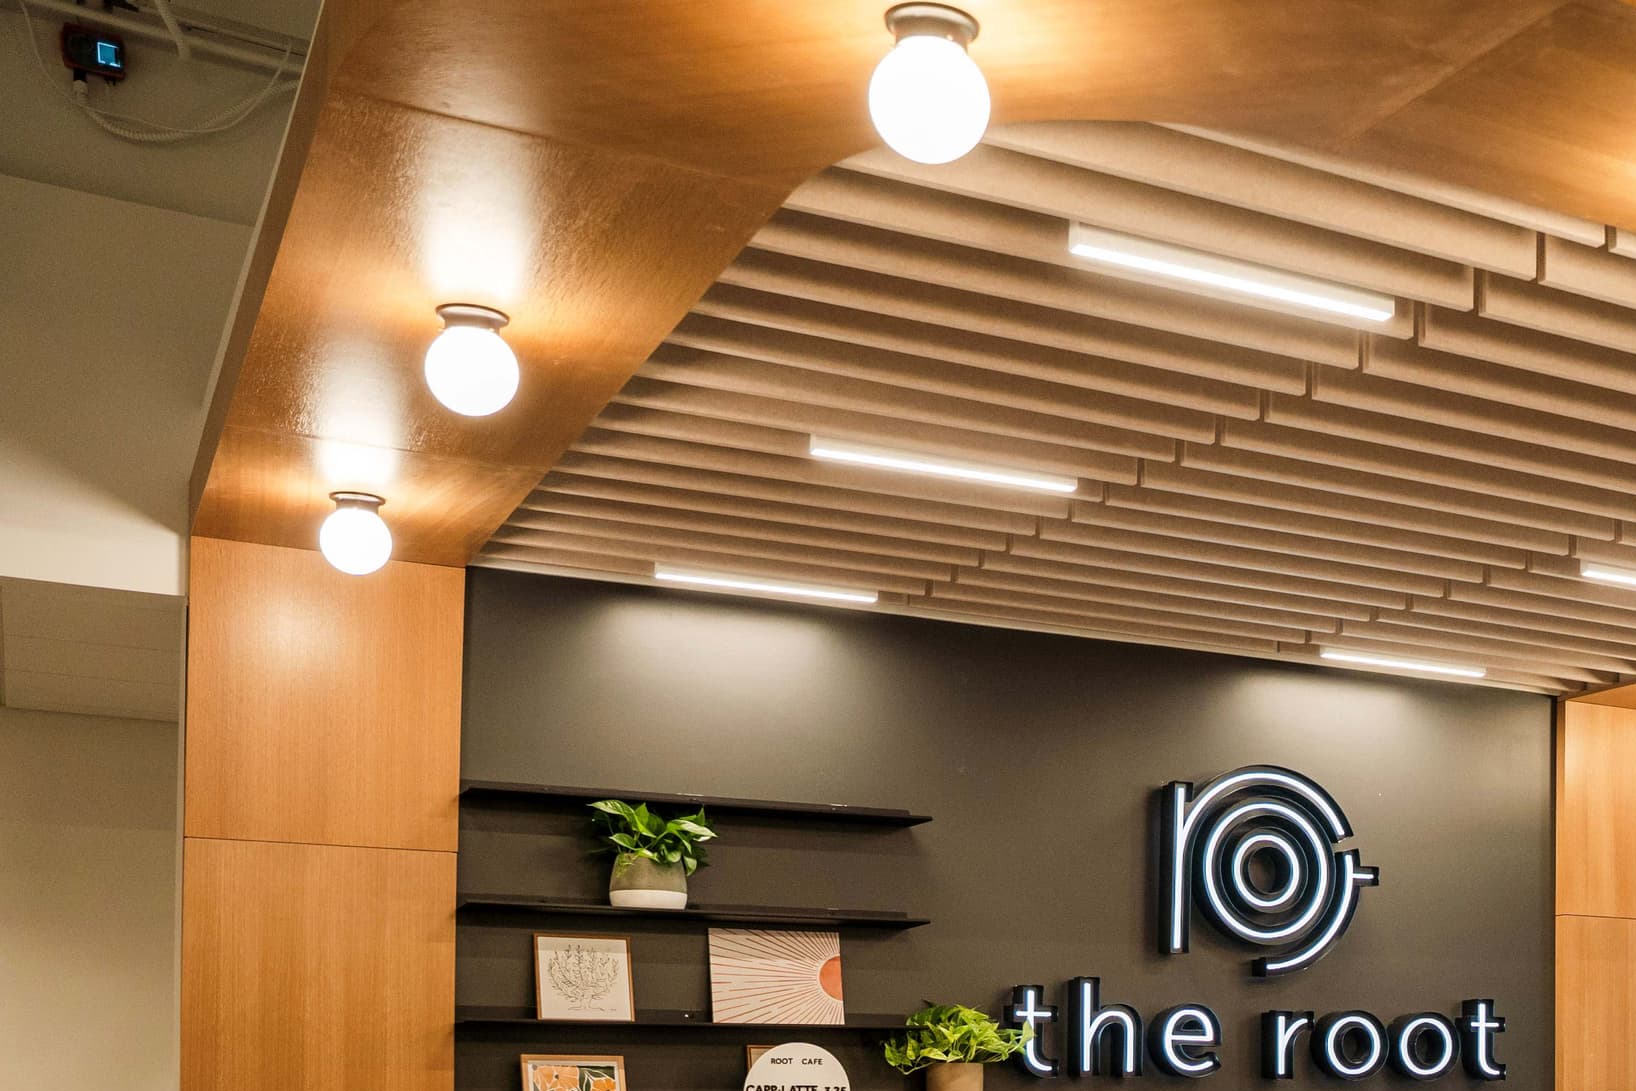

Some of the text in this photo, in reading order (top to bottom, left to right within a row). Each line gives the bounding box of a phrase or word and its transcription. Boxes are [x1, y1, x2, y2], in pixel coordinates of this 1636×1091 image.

[1006, 978, 1505, 1080] the root
[770, 1057, 823, 1066] ROOT CAFE
